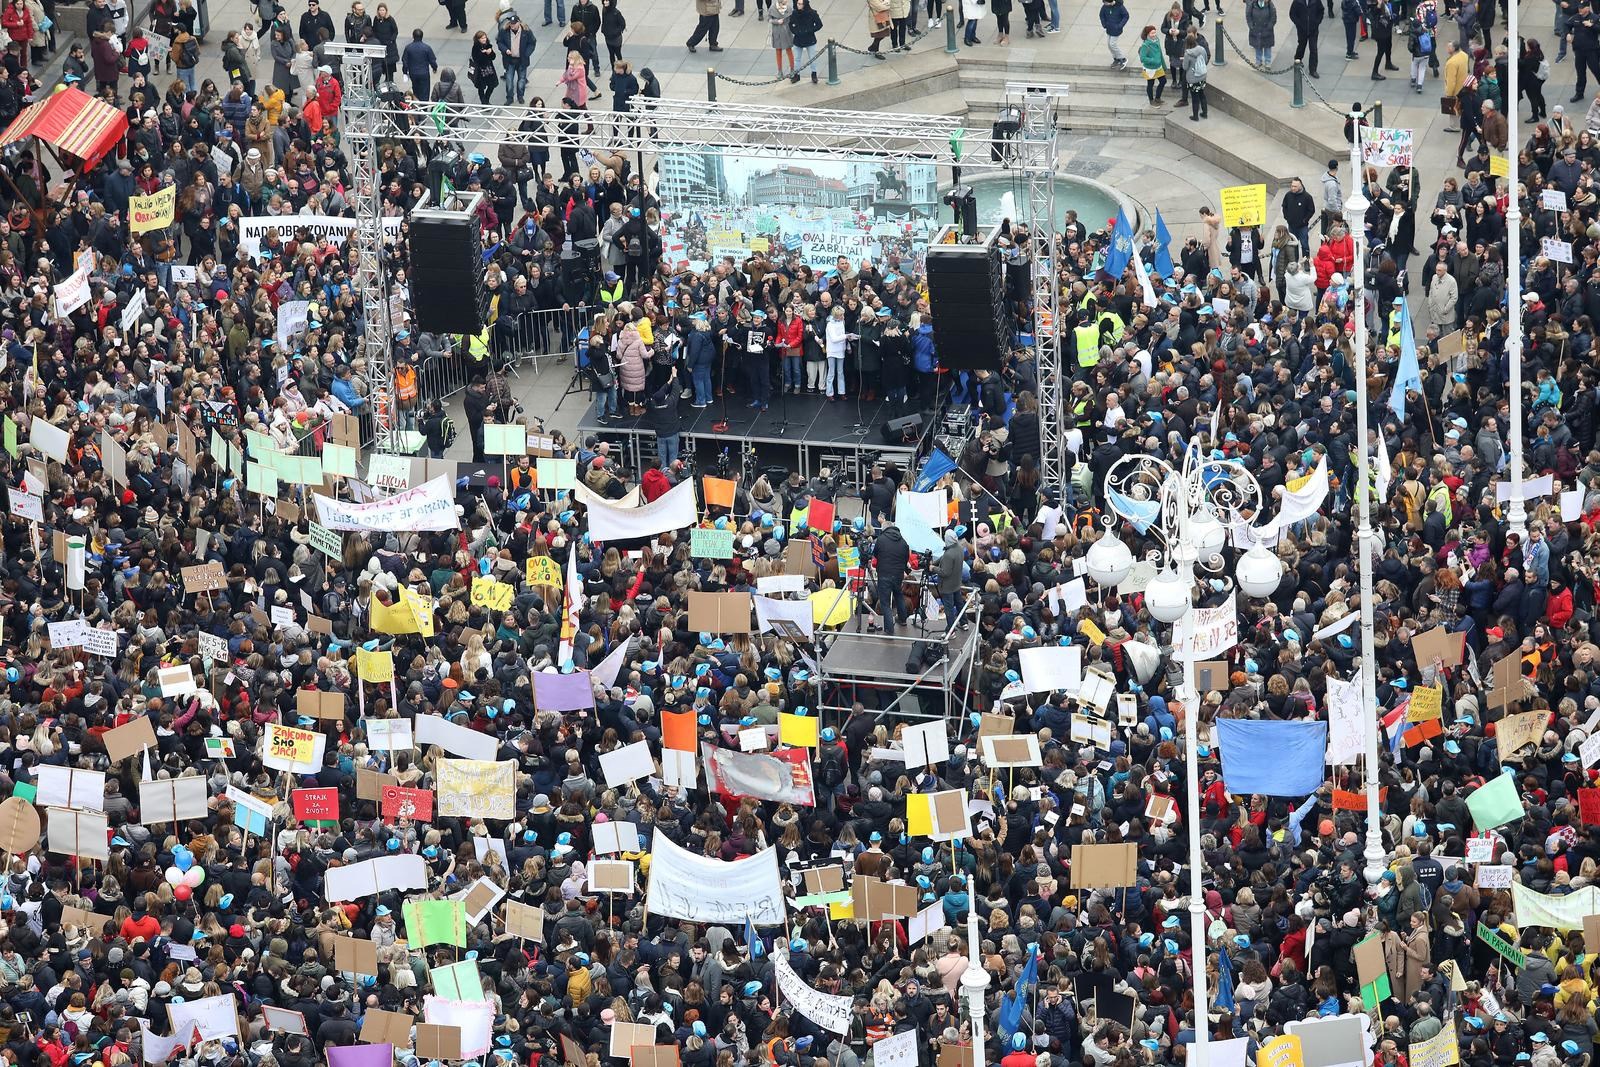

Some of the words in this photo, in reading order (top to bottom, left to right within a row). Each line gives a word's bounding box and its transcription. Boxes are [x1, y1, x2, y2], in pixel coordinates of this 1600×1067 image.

[803, 232, 825, 242] OVAJ
[831, 235, 848, 245] PUT
[853, 236, 872, 246] STE
[376, 474, 407, 488] LEKCIJA
[528, 558, 547, 568] OVO
[273, 726, 313, 741] ZAJEDNO
[273, 736, 294, 747] SMO
[1480, 927, 1490, 941] NO
